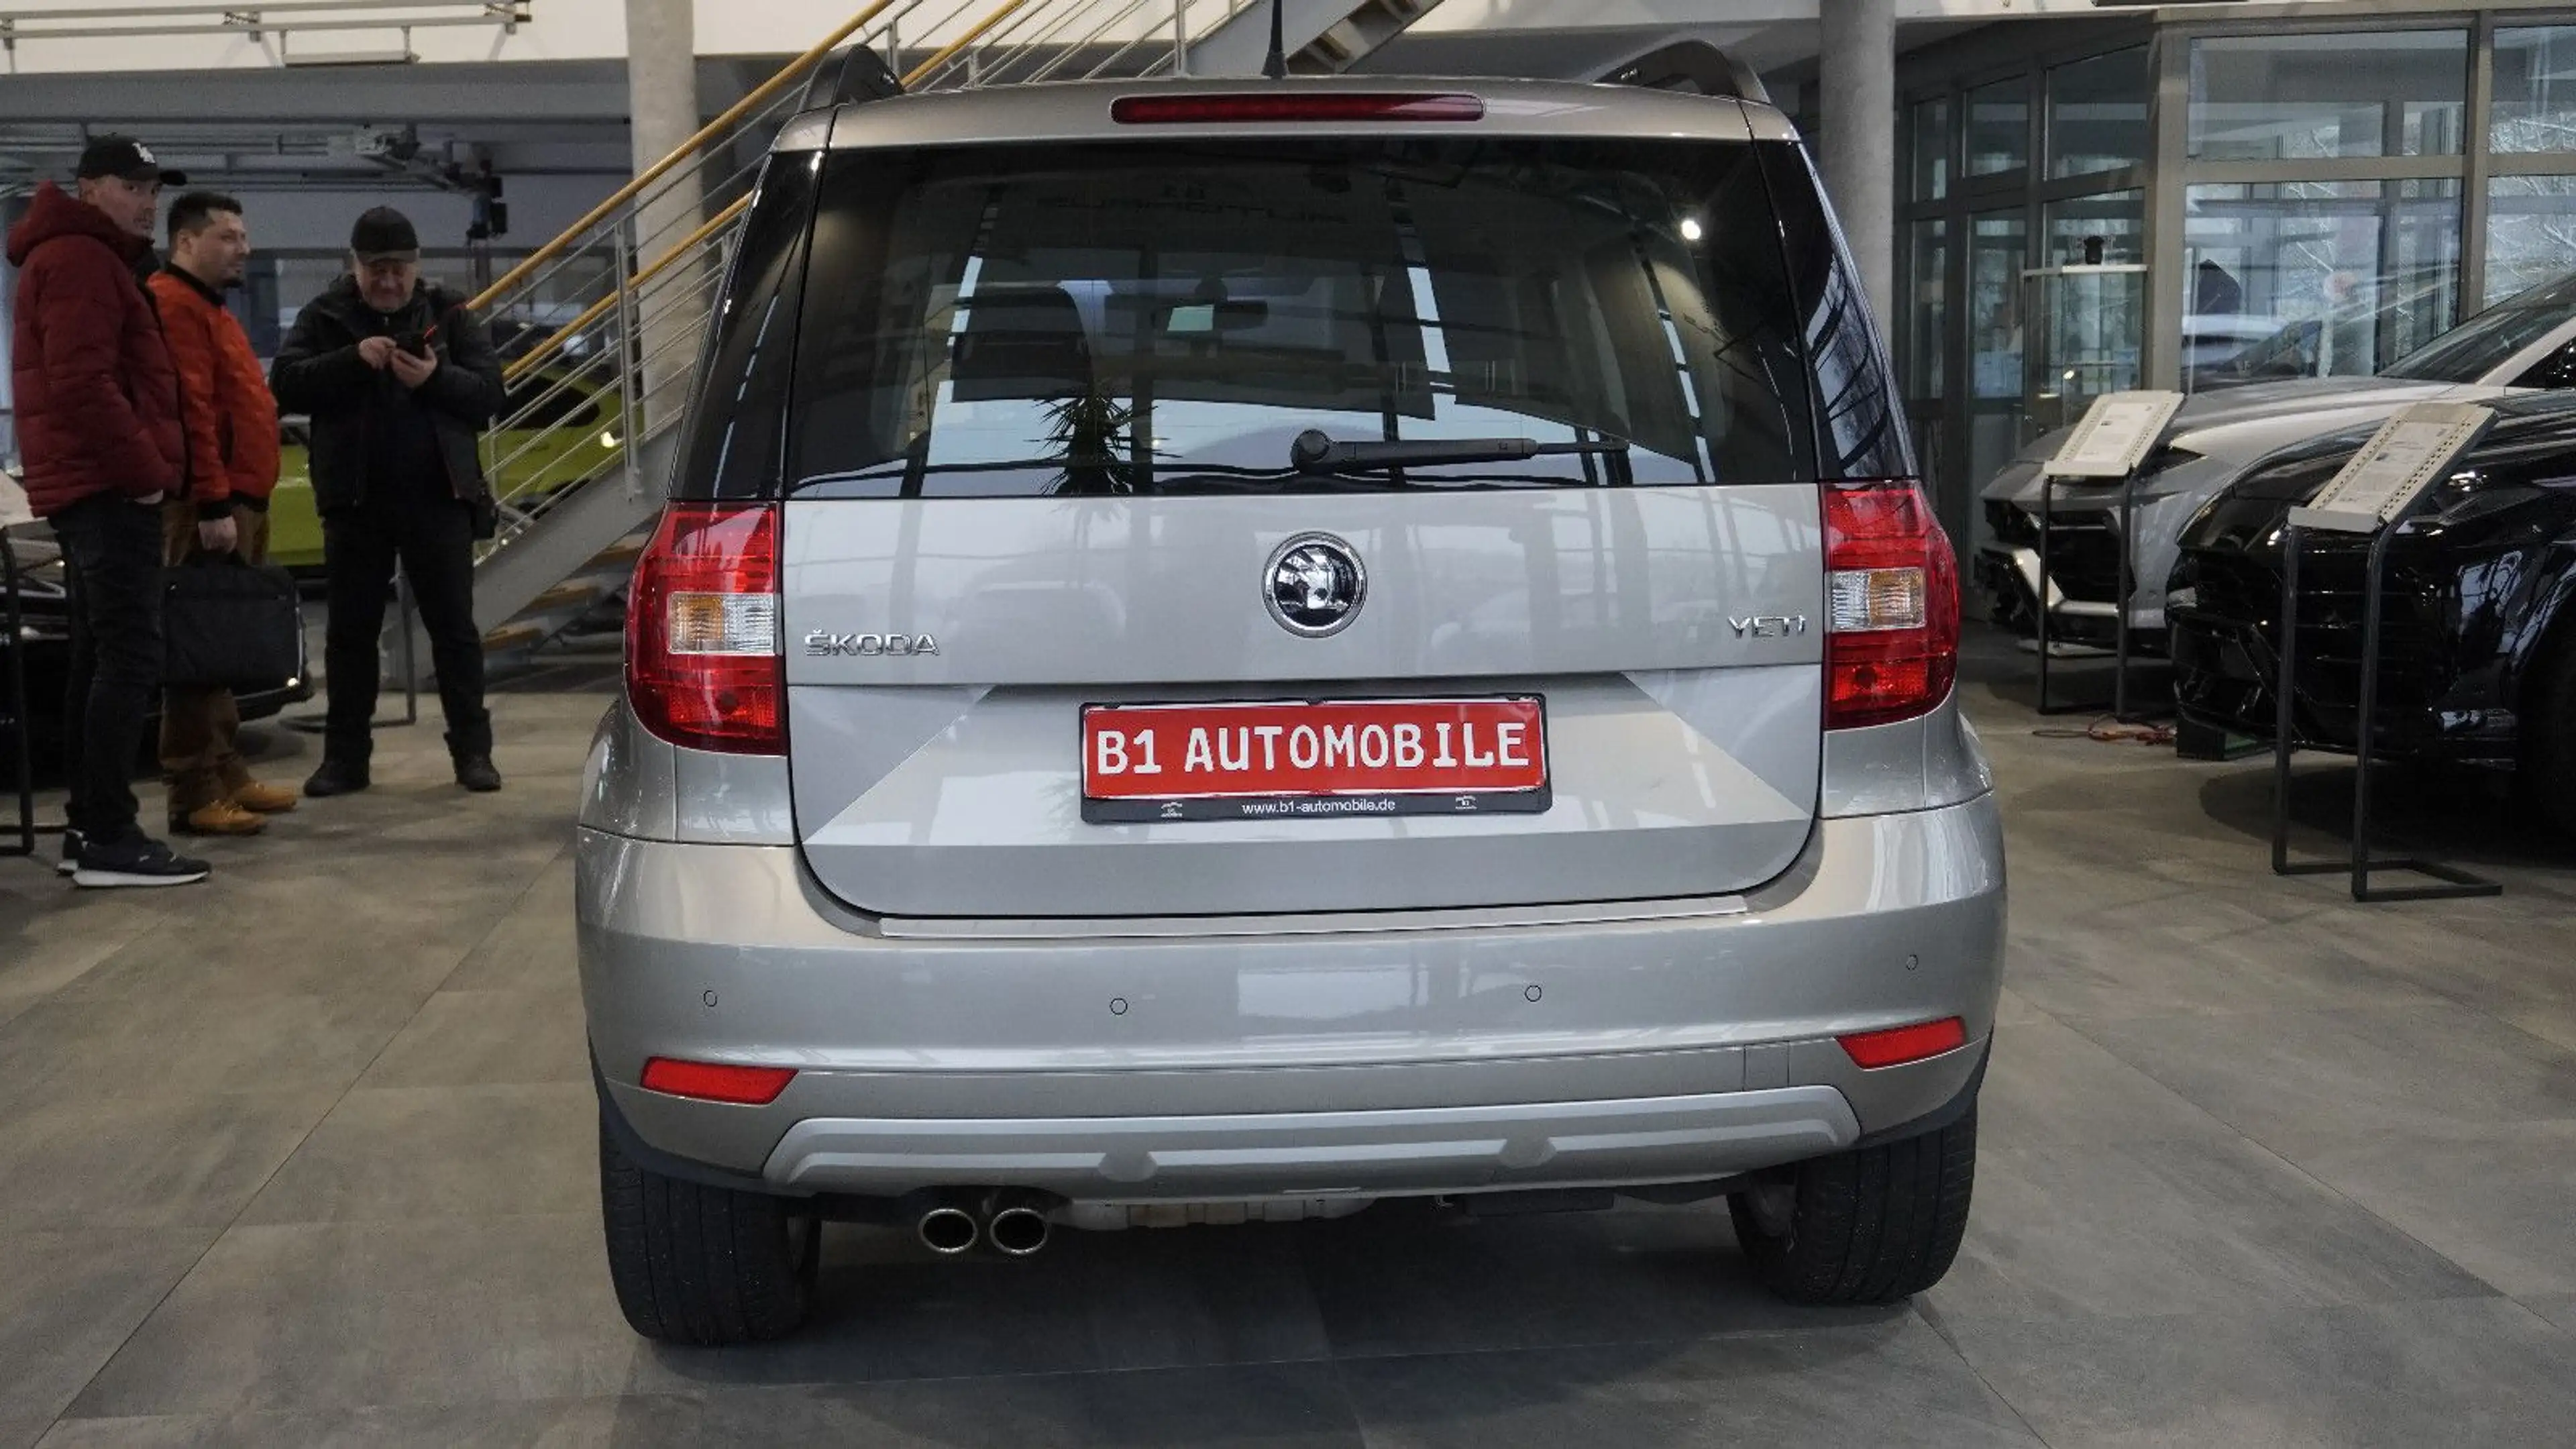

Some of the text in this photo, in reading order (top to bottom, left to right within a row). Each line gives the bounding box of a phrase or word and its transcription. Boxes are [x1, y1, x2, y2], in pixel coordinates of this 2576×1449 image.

[1727, 614, 1807, 638] YETI
[804, 628, 941, 656] ŠKODA
[1097, 722, 1529, 774] B1 AUTOMOBILE
[1242, 798, 1396, 814] www.b1-automobile.de
